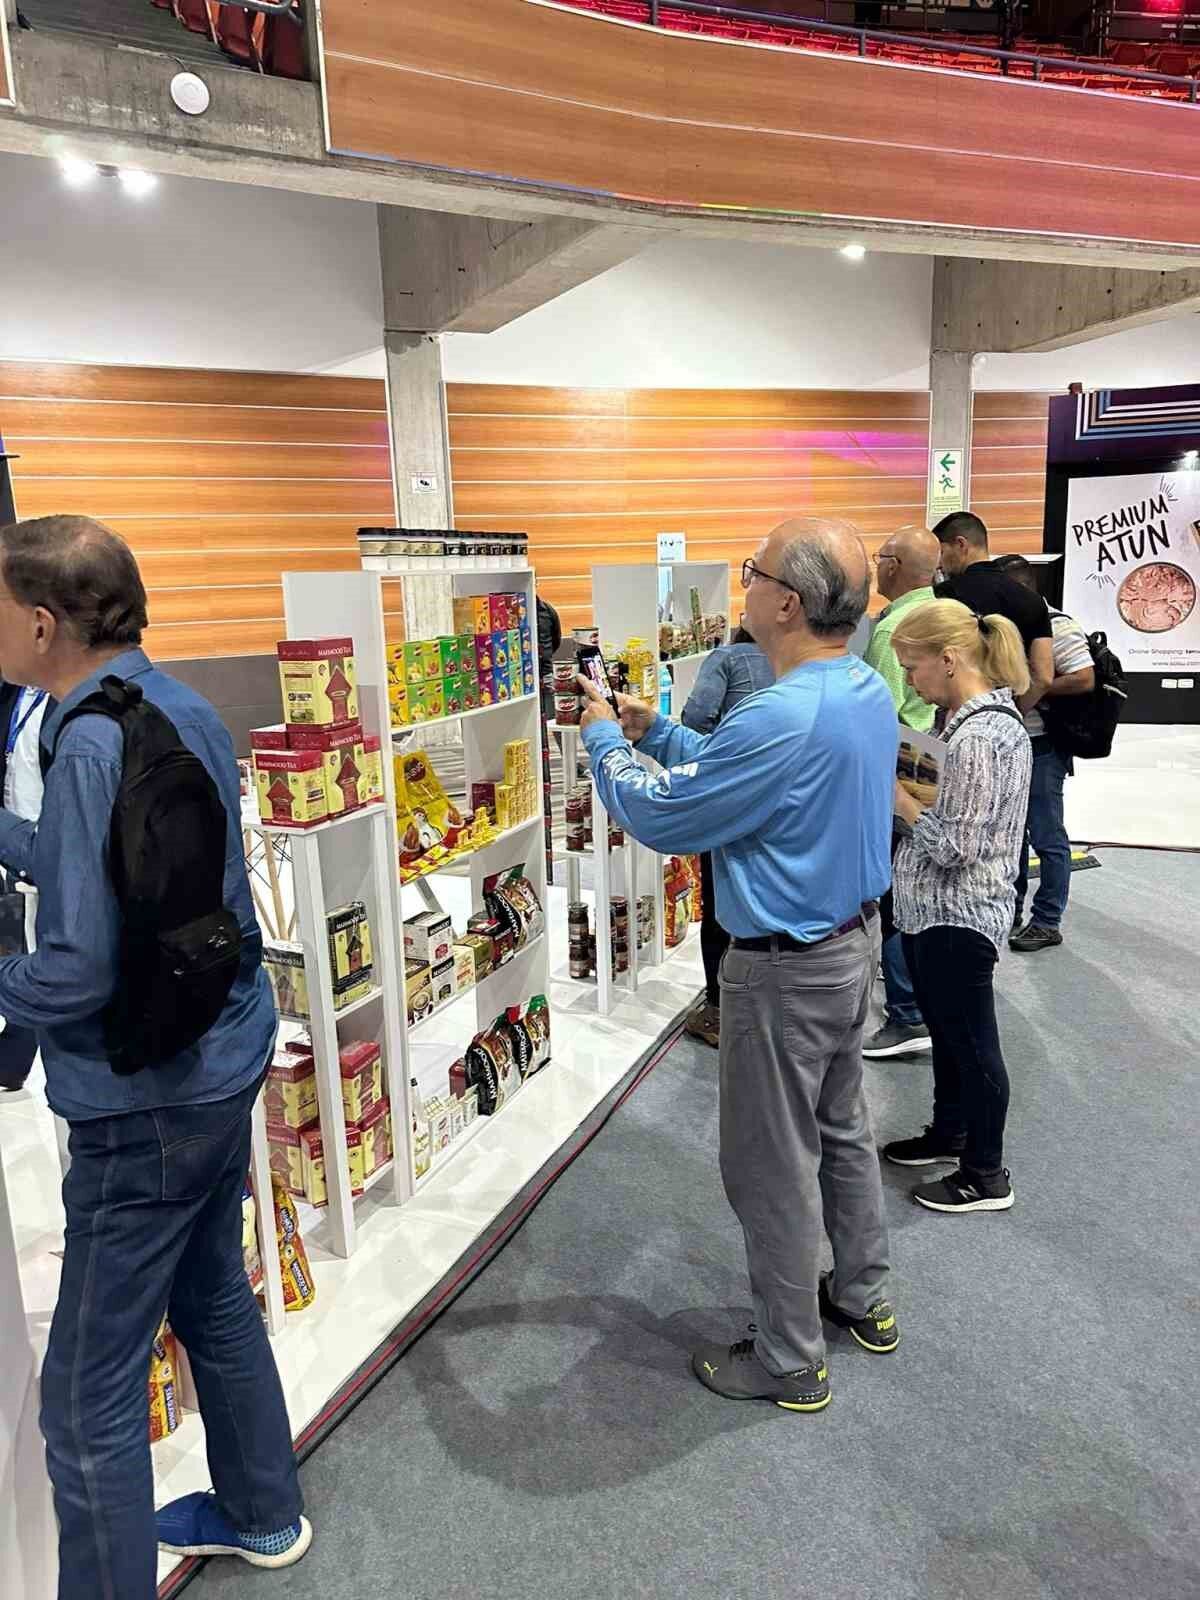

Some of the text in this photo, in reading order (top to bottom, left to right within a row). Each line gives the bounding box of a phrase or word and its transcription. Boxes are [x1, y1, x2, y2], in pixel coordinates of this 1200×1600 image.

[1072, 494, 1169, 546] PREMIUM
[1096, 520, 1170, 572] ATUN
[957, 1184, 982, 1201] N
